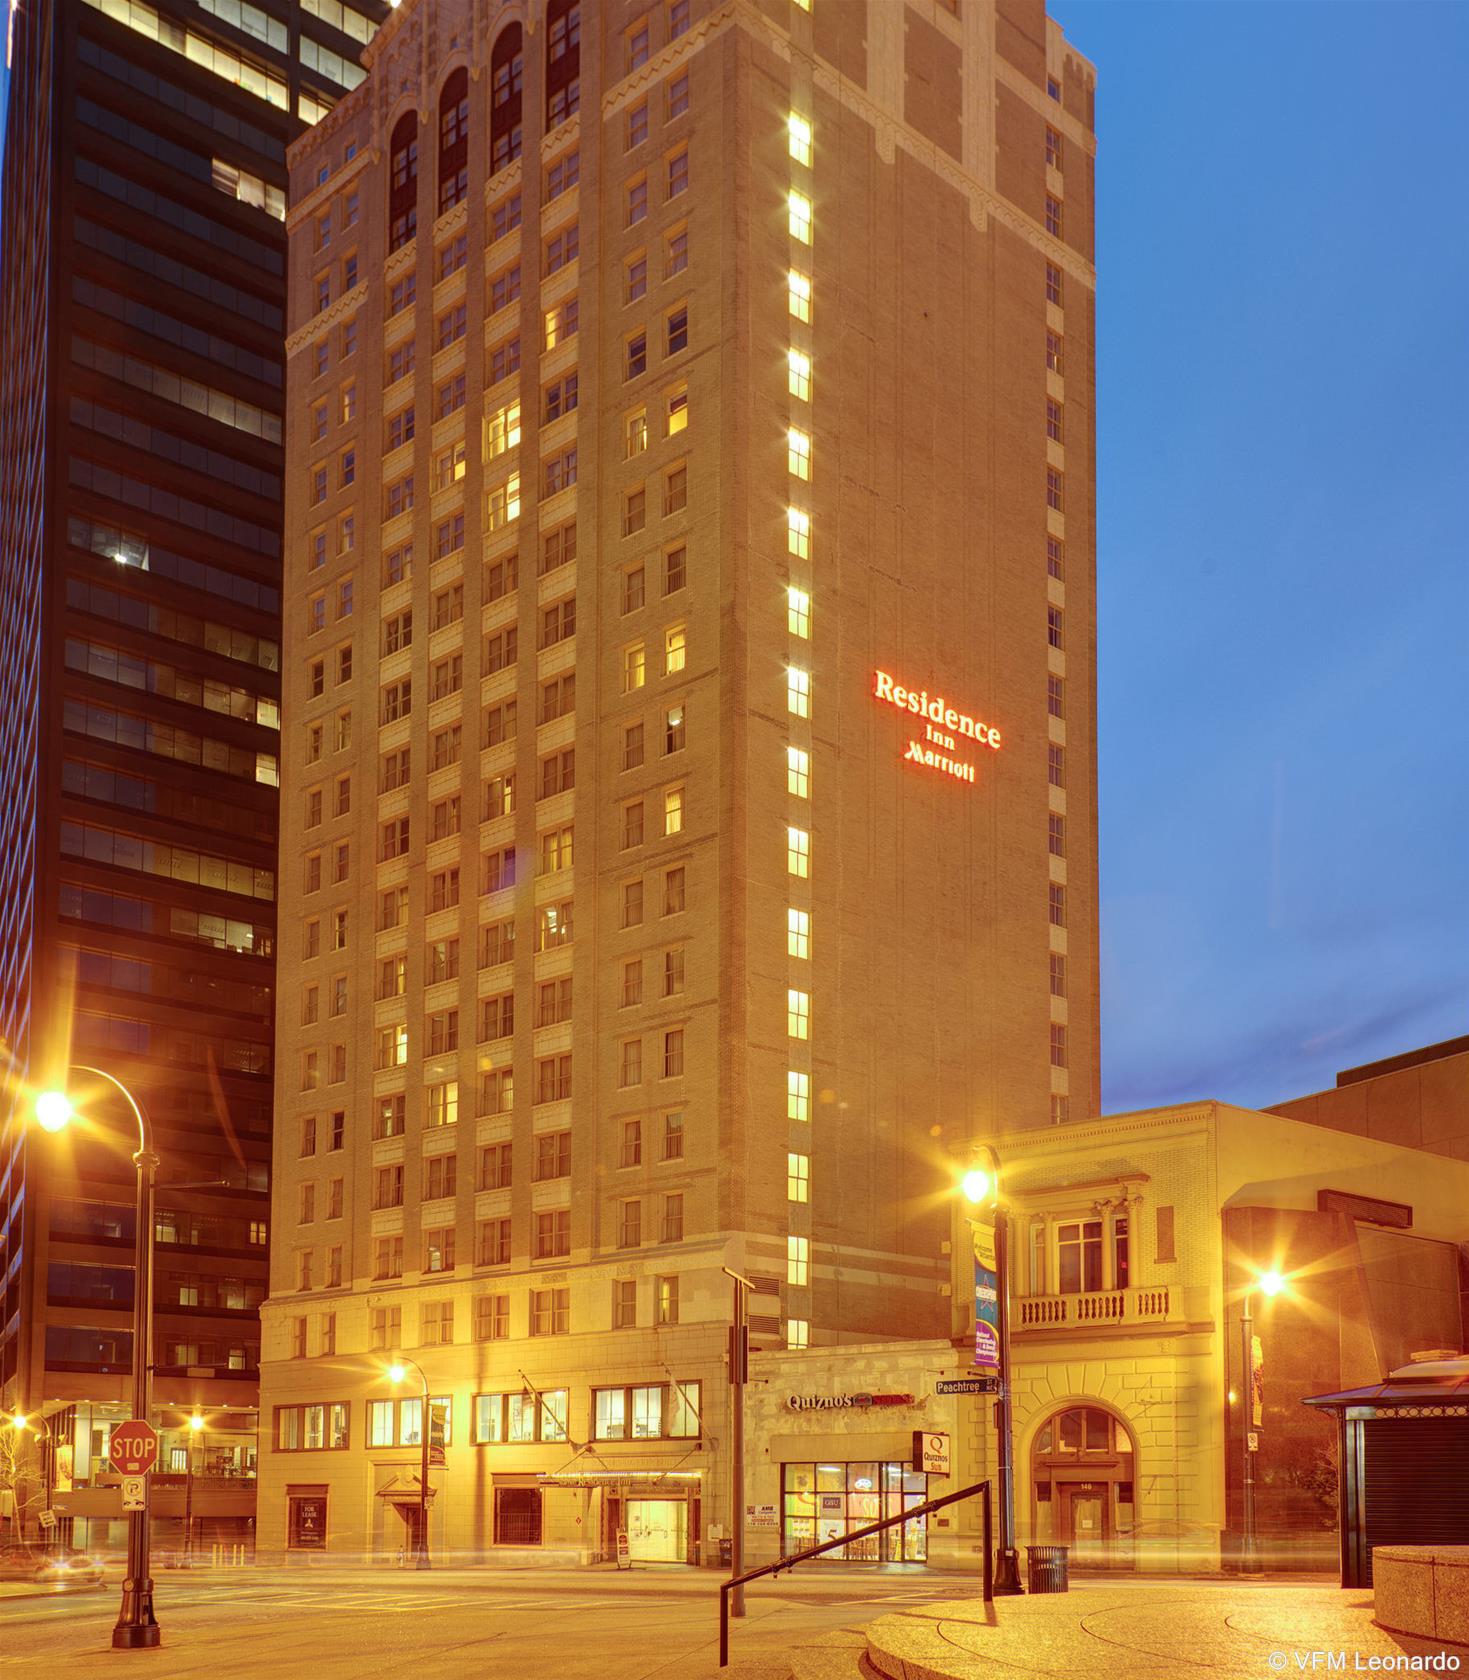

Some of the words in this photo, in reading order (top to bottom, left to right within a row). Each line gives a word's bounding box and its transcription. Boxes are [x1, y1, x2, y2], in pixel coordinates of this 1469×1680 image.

[875, 670, 1001, 749] Residence
[926, 724, 955, 750] Inn
[904, 740, 975, 783] Marriott
[937, 1382, 980, 1393] Peachtree
[787, 1393, 854, 1412] Quizno's
[112, 1438, 155, 1458] STOP
[924, 1452, 949, 1463] Quiznos
